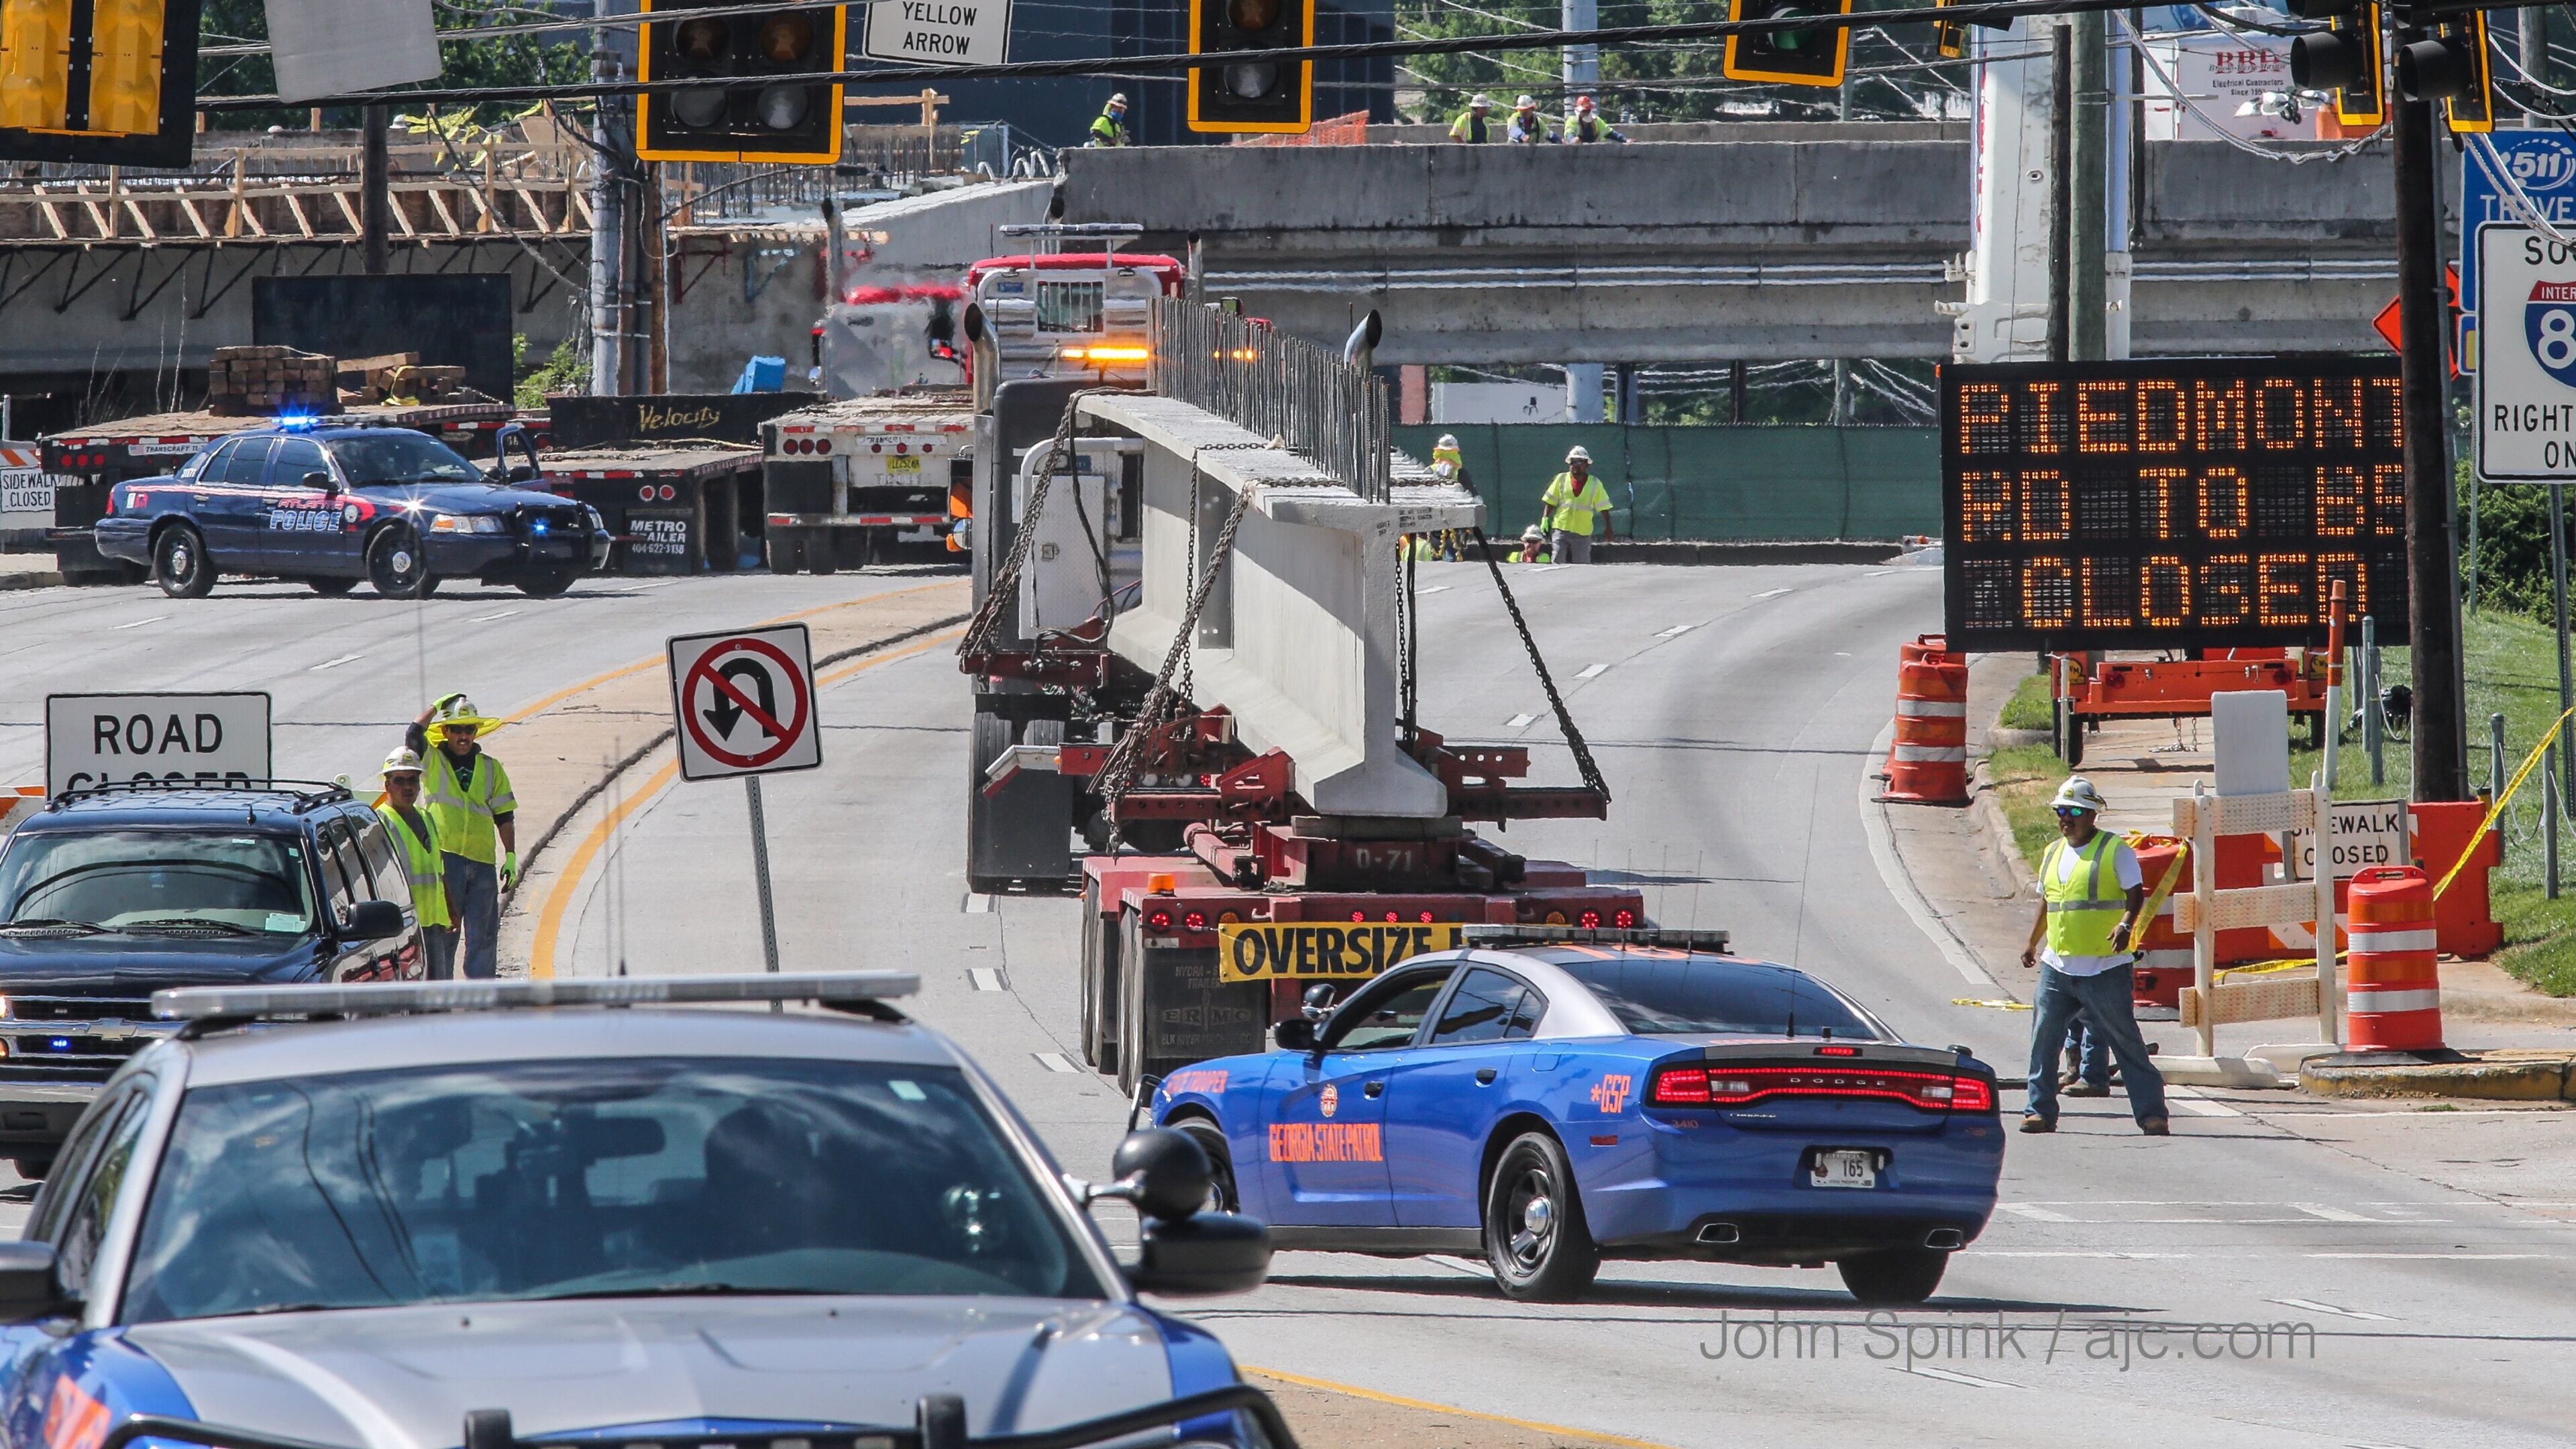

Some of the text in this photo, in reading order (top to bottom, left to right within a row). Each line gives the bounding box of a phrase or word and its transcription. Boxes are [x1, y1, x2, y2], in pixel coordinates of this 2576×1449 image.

[903, 1, 977, 25] YELLOW
[903, 32, 970, 55] ARROW
[2246, 78, 2284, 87] Contractors
[2512, 152, 2561, 178] 511
[2524, 235, 2576, 266] SO
[638, 404, 720, 431] Velocity
[2494, 404, 2574, 431] RIGHT
[145, 444, 190, 453] TRANSCRAFT
[3, 472, 60, 490] SIDEWALK
[10, 491, 51, 507] CLOSED
[1962, 470, 2071, 542] RD
[2140, 468, 2247, 537] TO
[270, 510, 343, 531] POLICE
[631, 520, 686, 533] METRO
[630, 531, 686, 543] AILER
[2023, 554, 2367, 627] CLOSED
[94, 713, 223, 755] ROAD
[2292, 814, 2400, 837] EWALK
[1356, 848, 1411, 871] D-71
[2304, 845, 2388, 866] COSED
[1233, 926, 1433, 975] OVERSIZE
[1790, 1077, 1886, 1086] DODGE
[1269, 1123, 1384, 1162] GEORGIA STATE PATROL
[1843, 1160, 1864, 1177] 165
